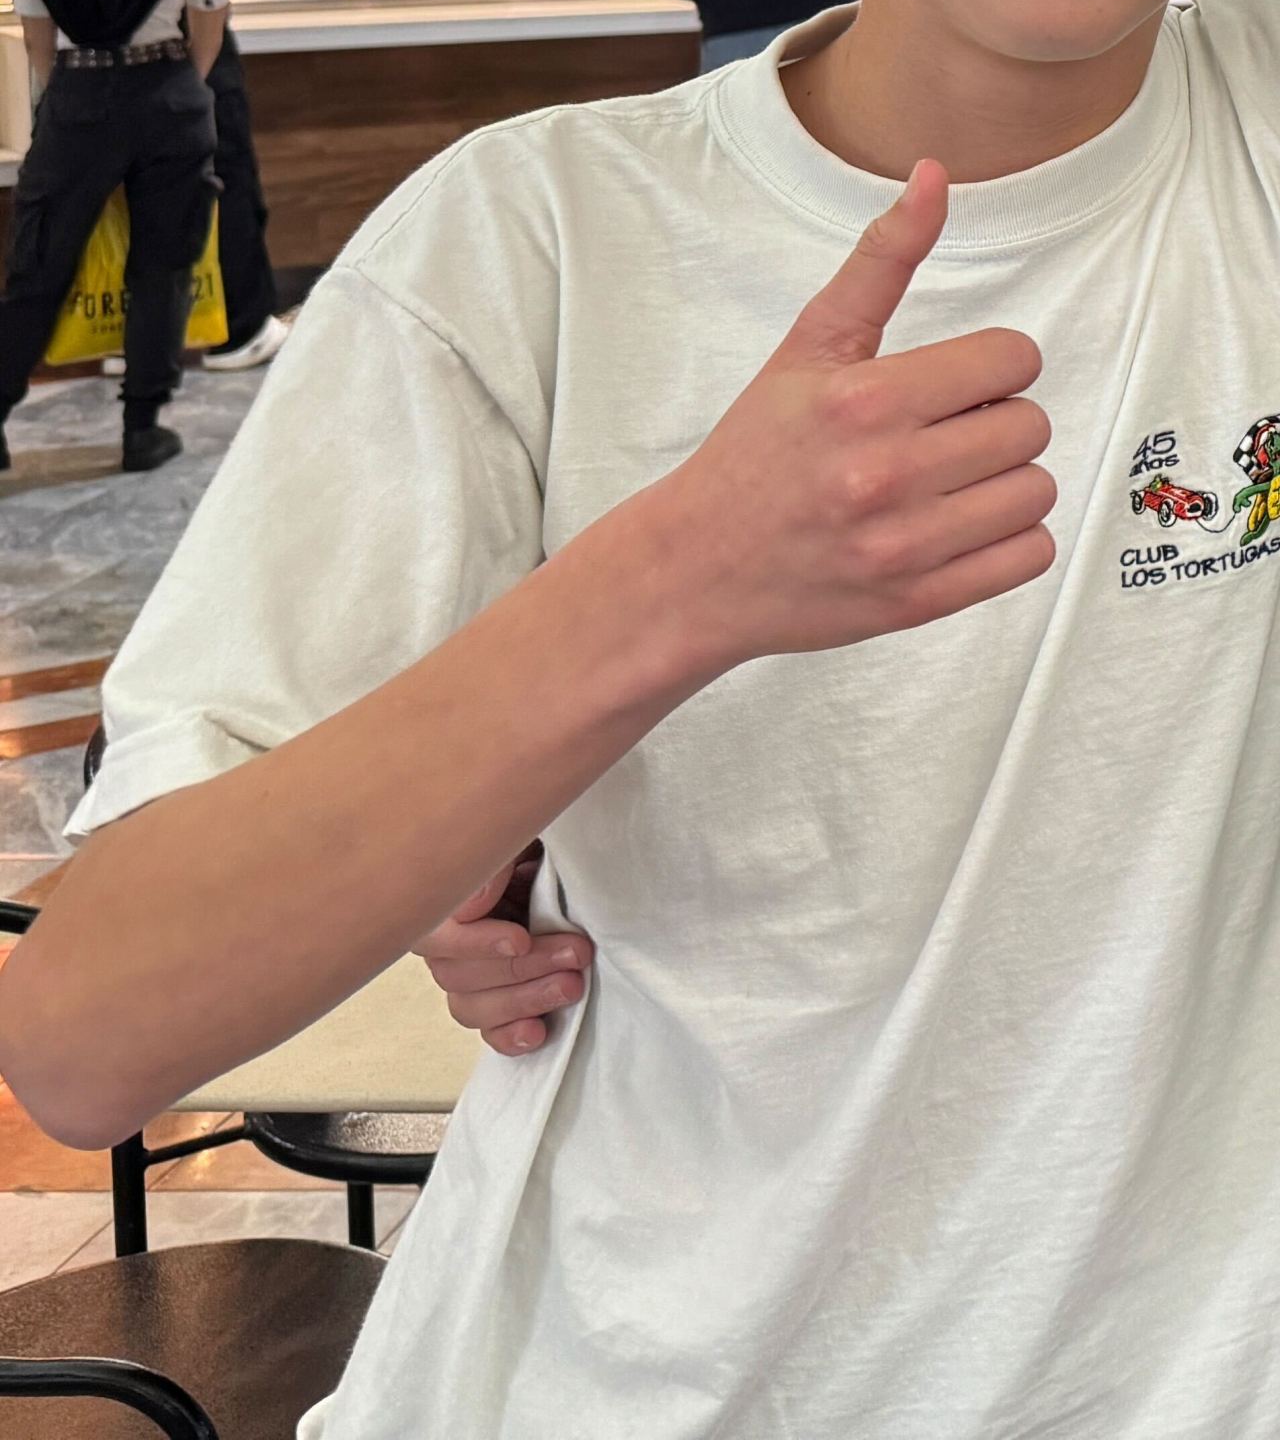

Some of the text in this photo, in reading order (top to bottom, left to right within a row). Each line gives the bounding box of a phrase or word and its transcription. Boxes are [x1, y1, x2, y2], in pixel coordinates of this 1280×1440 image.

[1132, 430, 1176, 460] 45
[1120, 544, 1179, 567] CLUB
[1121, 567, 1167, 588] LOS
